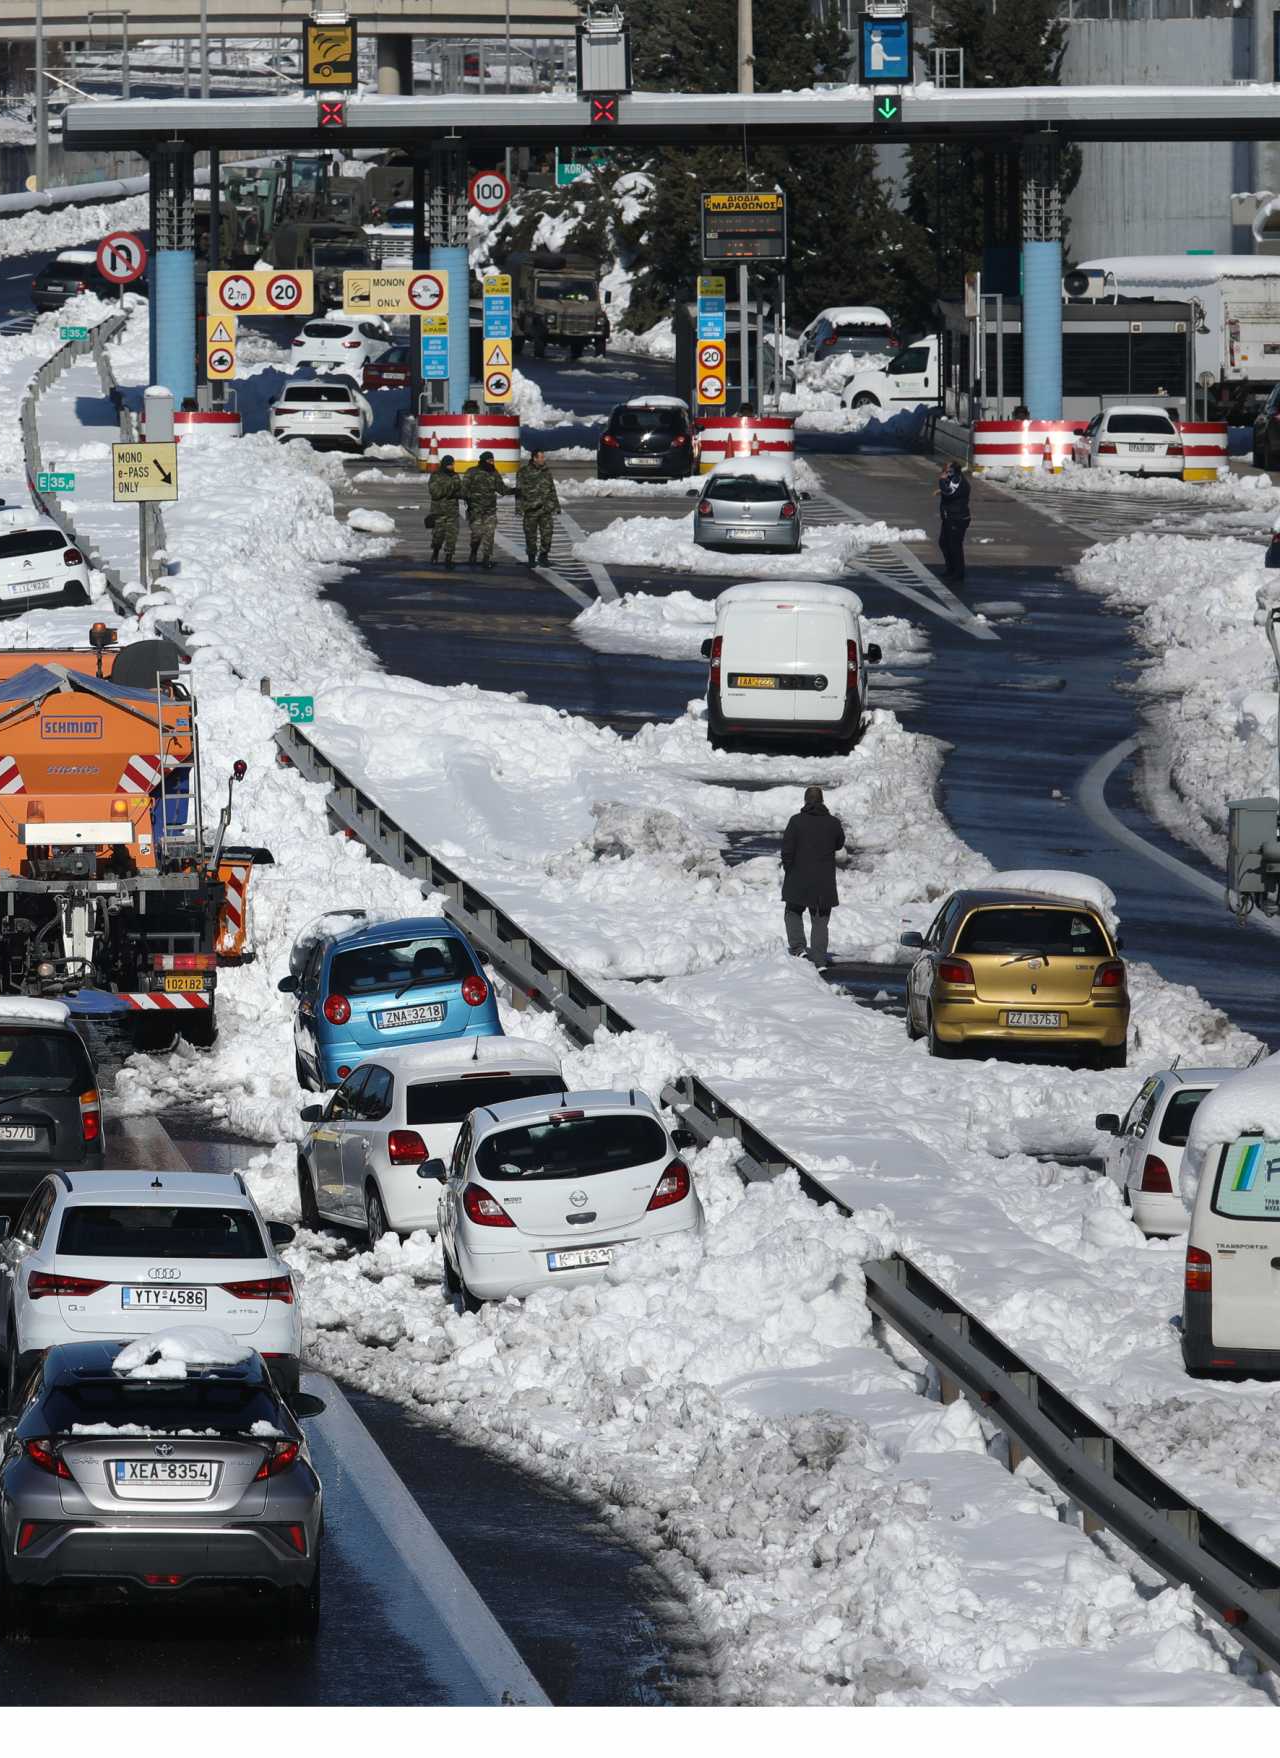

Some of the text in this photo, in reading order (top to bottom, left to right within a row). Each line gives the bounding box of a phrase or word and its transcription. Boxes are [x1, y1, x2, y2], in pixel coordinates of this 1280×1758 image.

[476, 184, 504, 200] 100
[274, 285, 295, 300] 20
[377, 300, 401, 308] ONLY
[704, 352, 719, 362] 20
[118, 466, 149, 479] e-PASS
[40, 477, 47, 488] E
[118, 481, 140, 493] ONLY
[45, 721, 98, 734] SCHMIDT
